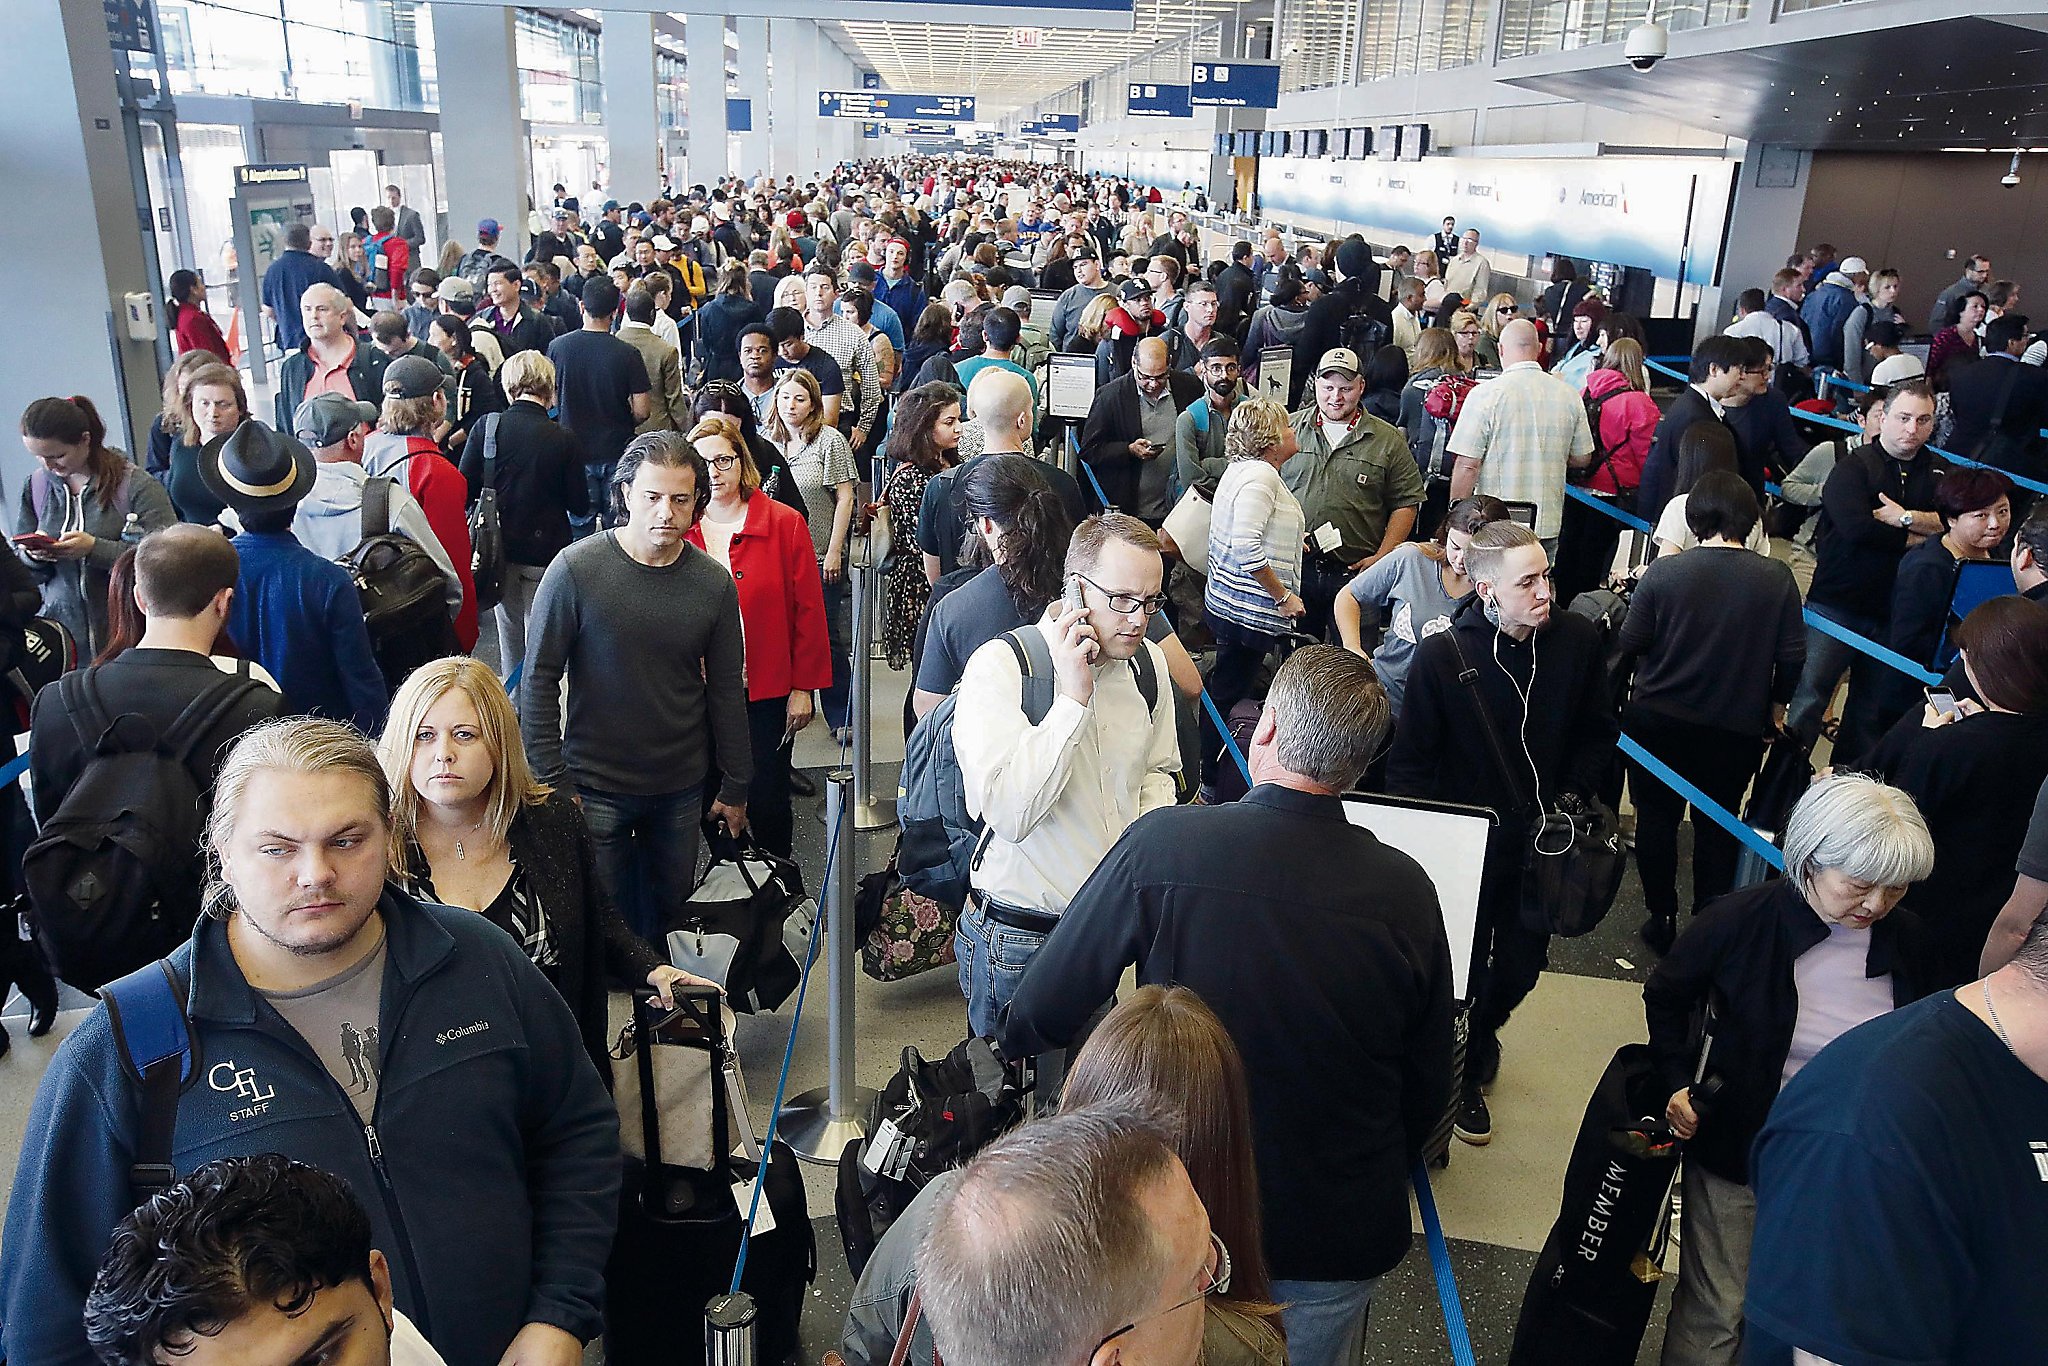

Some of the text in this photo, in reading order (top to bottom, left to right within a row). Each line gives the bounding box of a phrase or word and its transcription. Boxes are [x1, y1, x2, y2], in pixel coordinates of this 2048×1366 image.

[1017, 30, 1038, 44] EXIT
[1193, 65, 1208, 83] B
[1130, 85, 1141, 99] B
[1043, 114, 1051, 123] C
[1579, 188, 1618, 208] American
[446, 1020, 490, 1040] Columbia
[208, 1060, 275, 1102] CFL
[229, 1101, 269, 1122] STAFF
[1577, 1160, 1628, 1262] MEMBER
